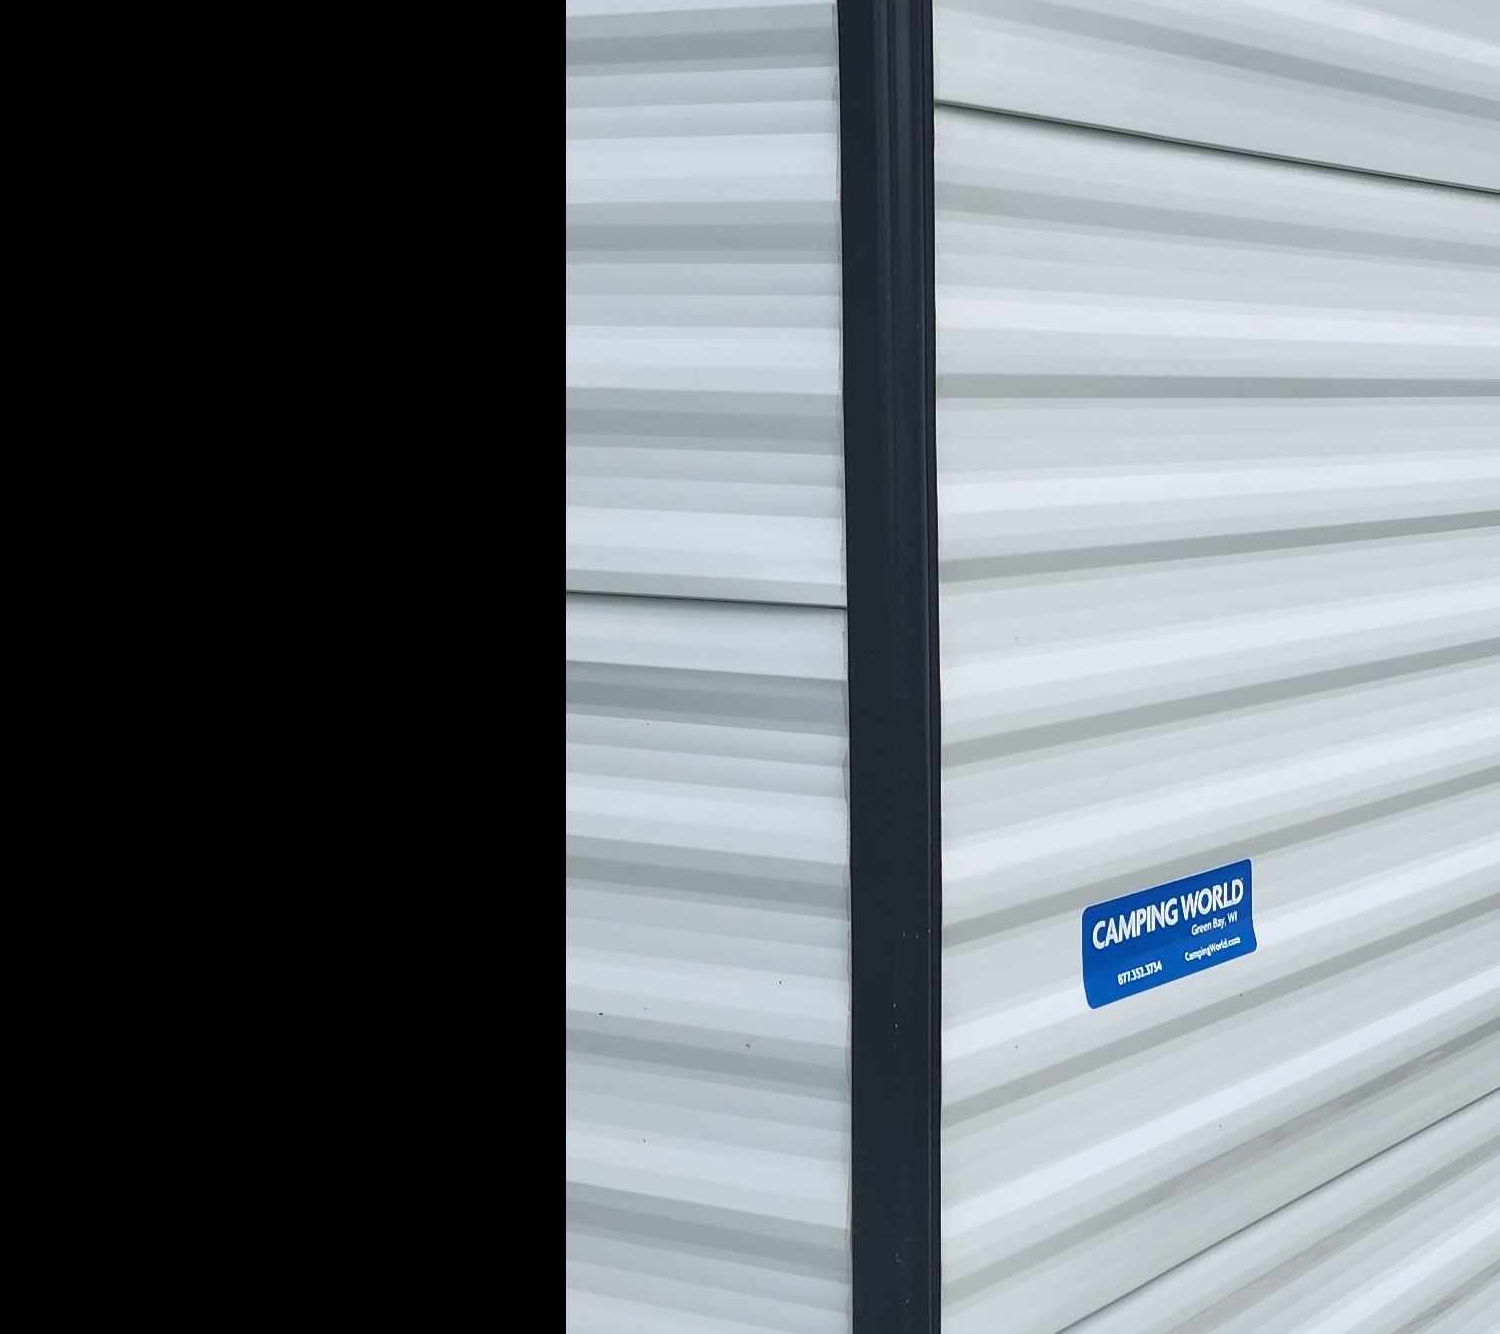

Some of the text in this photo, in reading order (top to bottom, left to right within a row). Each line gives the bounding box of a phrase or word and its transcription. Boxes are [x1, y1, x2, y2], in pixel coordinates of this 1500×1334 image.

[1092, 878, 1244, 950] CAMPING WORLD
[1191, 910, 1238, 936] Green Bay, WI
[1184, 936, 1241, 962] CampingWorld.com
